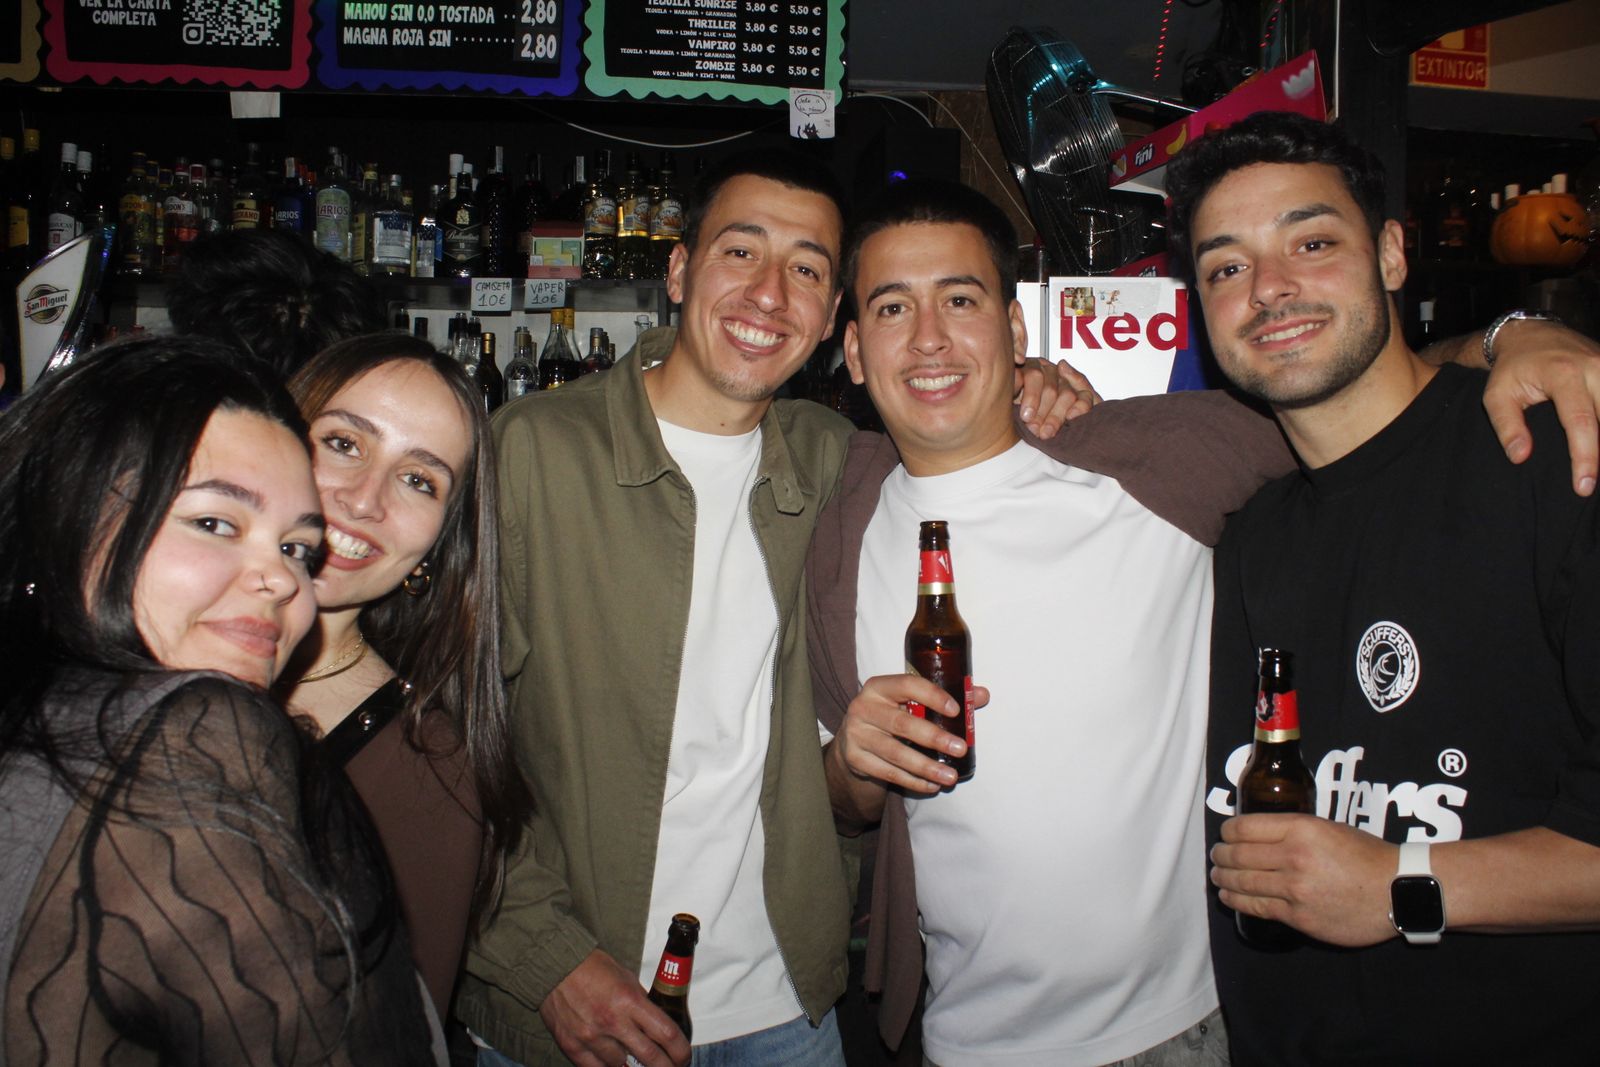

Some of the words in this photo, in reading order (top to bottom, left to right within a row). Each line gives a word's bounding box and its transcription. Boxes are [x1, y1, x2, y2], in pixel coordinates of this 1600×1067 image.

[79, 0, 99, 8] VER
[107, 0, 124, 8] LA
[127, 0, 171, 10] CARTA
[344, 2, 386, 21] MAHOU
[391, 4, 413, 22] SIN
[417, 5, 435, 24] 0,0
[439, 6, 495, 24] TOSTADA
[520, 0, 557, 27] 2,80
[694, 0, 737, 10] SUNRISE
[769, 3, 779, 13] €
[812, 6, 822, 16] €
[92, 10, 157, 26] COMPLETA
[688, 18, 737, 30] THRILLER
[768, 24, 778, 34] €
[811, 27, 821, 37] €
[343, 27, 388, 46] MAGNA
[392, 28, 424, 47] ROJA
[428, 29, 452, 48] SIN
[520, 34, 557, 60] 2,80
[688, 39, 737, 51] VAMPIRO
[766, 43, 776, 54] €
[811, 46, 821, 57] €
[695, 60, 736, 72] ZOMBIE
[766, 64, 776, 74] €
[810, 67, 821, 77] €
[1417, 56, 1486, 81] EXTINTOR
[274, 209, 299, 222] LARIOS
[316, 204, 350, 218] LARIOS
[530, 282, 565, 294] VAPER
[1060, 288, 1189, 351] Red
[1361, 626, 1411, 658] SCUFFERS
